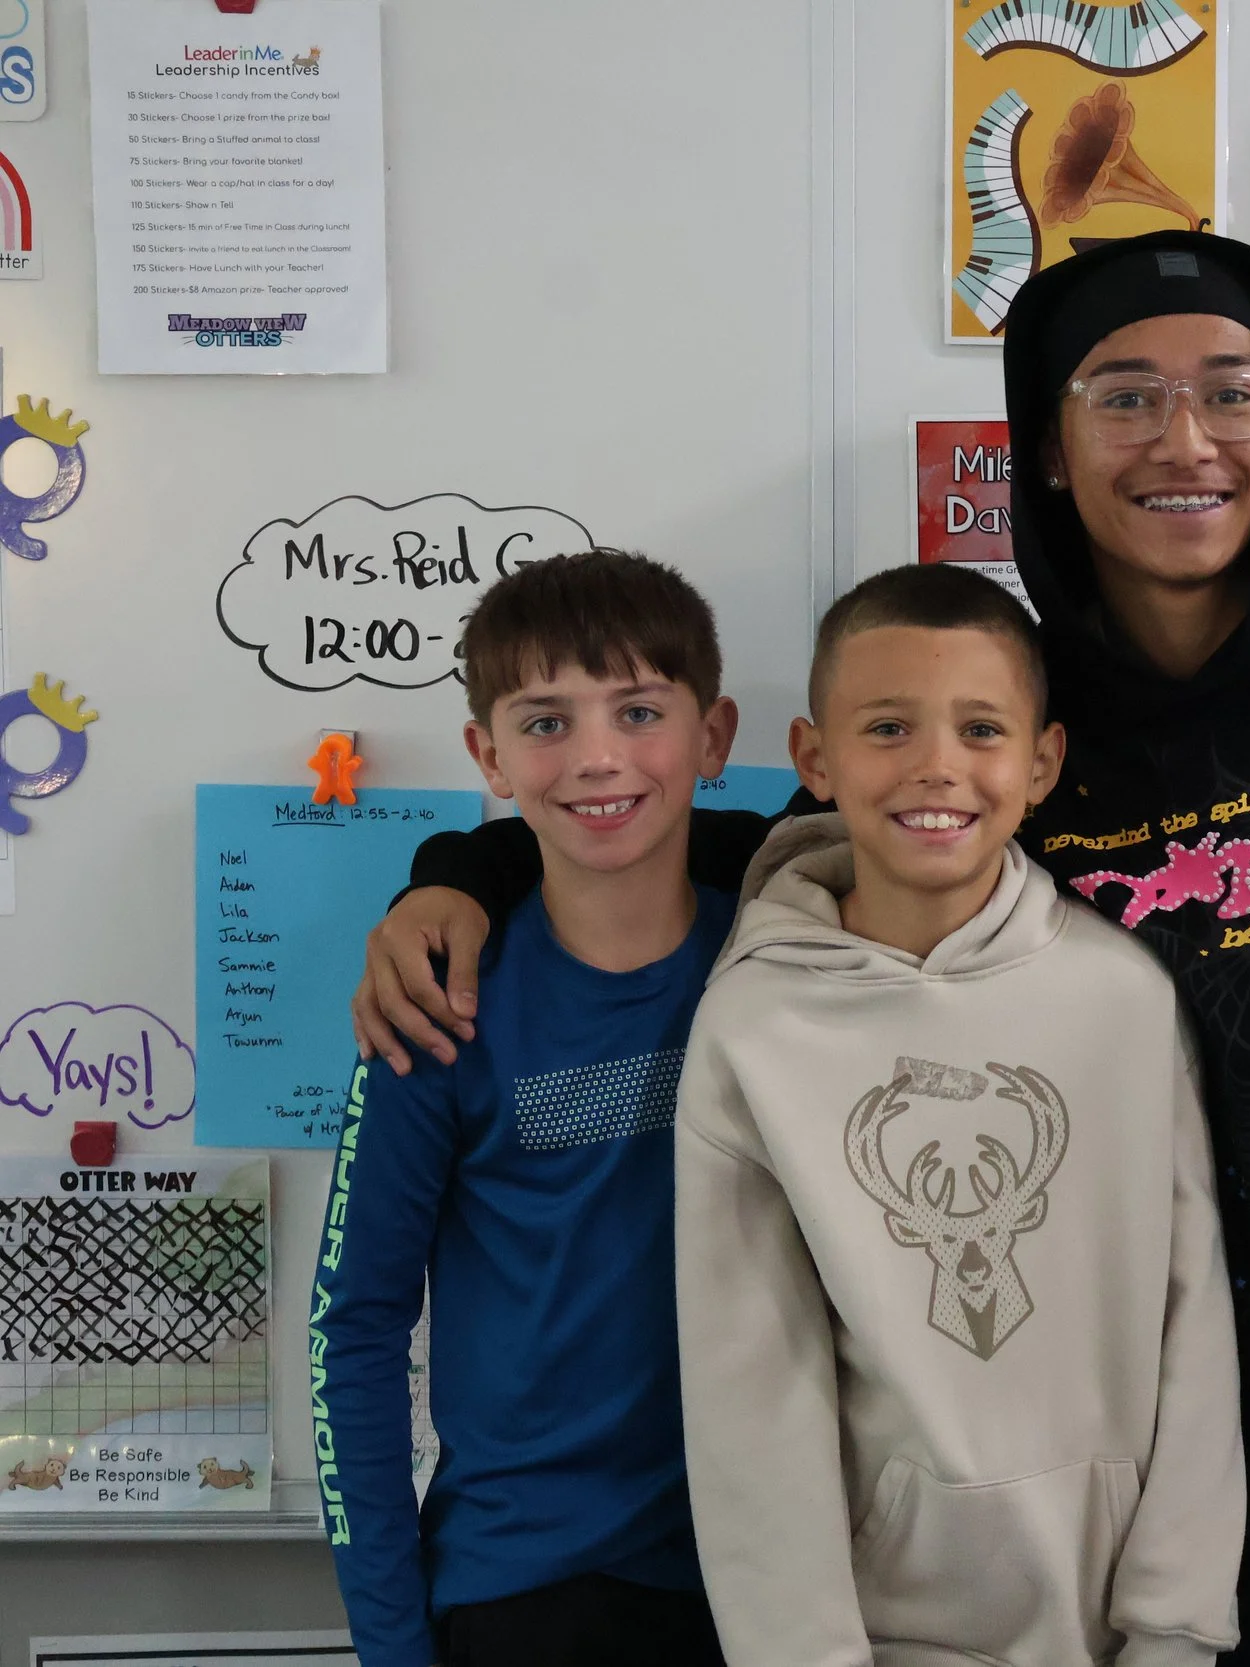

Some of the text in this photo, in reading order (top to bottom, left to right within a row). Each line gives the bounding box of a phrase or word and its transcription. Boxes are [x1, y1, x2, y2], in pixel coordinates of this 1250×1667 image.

[155, 63, 319, 78] Leadership Incentives
[127, 91, 136, 99] 15
[137, 91, 176, 99] Stickers-
[178, 91, 213, 99] Choose
[215, 91, 218, 99] 1
[220, 91, 248, 100] candy
[251, 91, 271, 99] from
[290, 91, 319, 100] Candy
[321, 91, 339, 99] box!
[133, 285, 148, 294] 200
[239, 287, 264, 295] prize-
[267, 285, 302, 293] Teacher
[304, 285, 348, 294] approved!
[168, 313, 252, 331] MEADOW
[195, 330, 283, 347] OTTERS
[1160, 812, 1198, 834] the
[220, 850, 247, 866] Noel
[220, 902, 249, 919] Lila
[218, 927, 280, 944] Jackson
[218, 957, 276, 973] Sammie
[225, 982, 276, 1002] Anthony
[225, 1007, 262, 1026] Arjun
[28, 1028, 156, 1111] Yays!
[321, 1064, 370, 1273] UNDER
[60, 1171, 198, 1195] OTTER WAY
[308, 1281, 351, 1547] ARMOUR
[99, 1449, 163, 1462] Be Safe
[69, 1469, 190, 1485] Be Responsible
[98, 1488, 159, 1501] Be Kind
